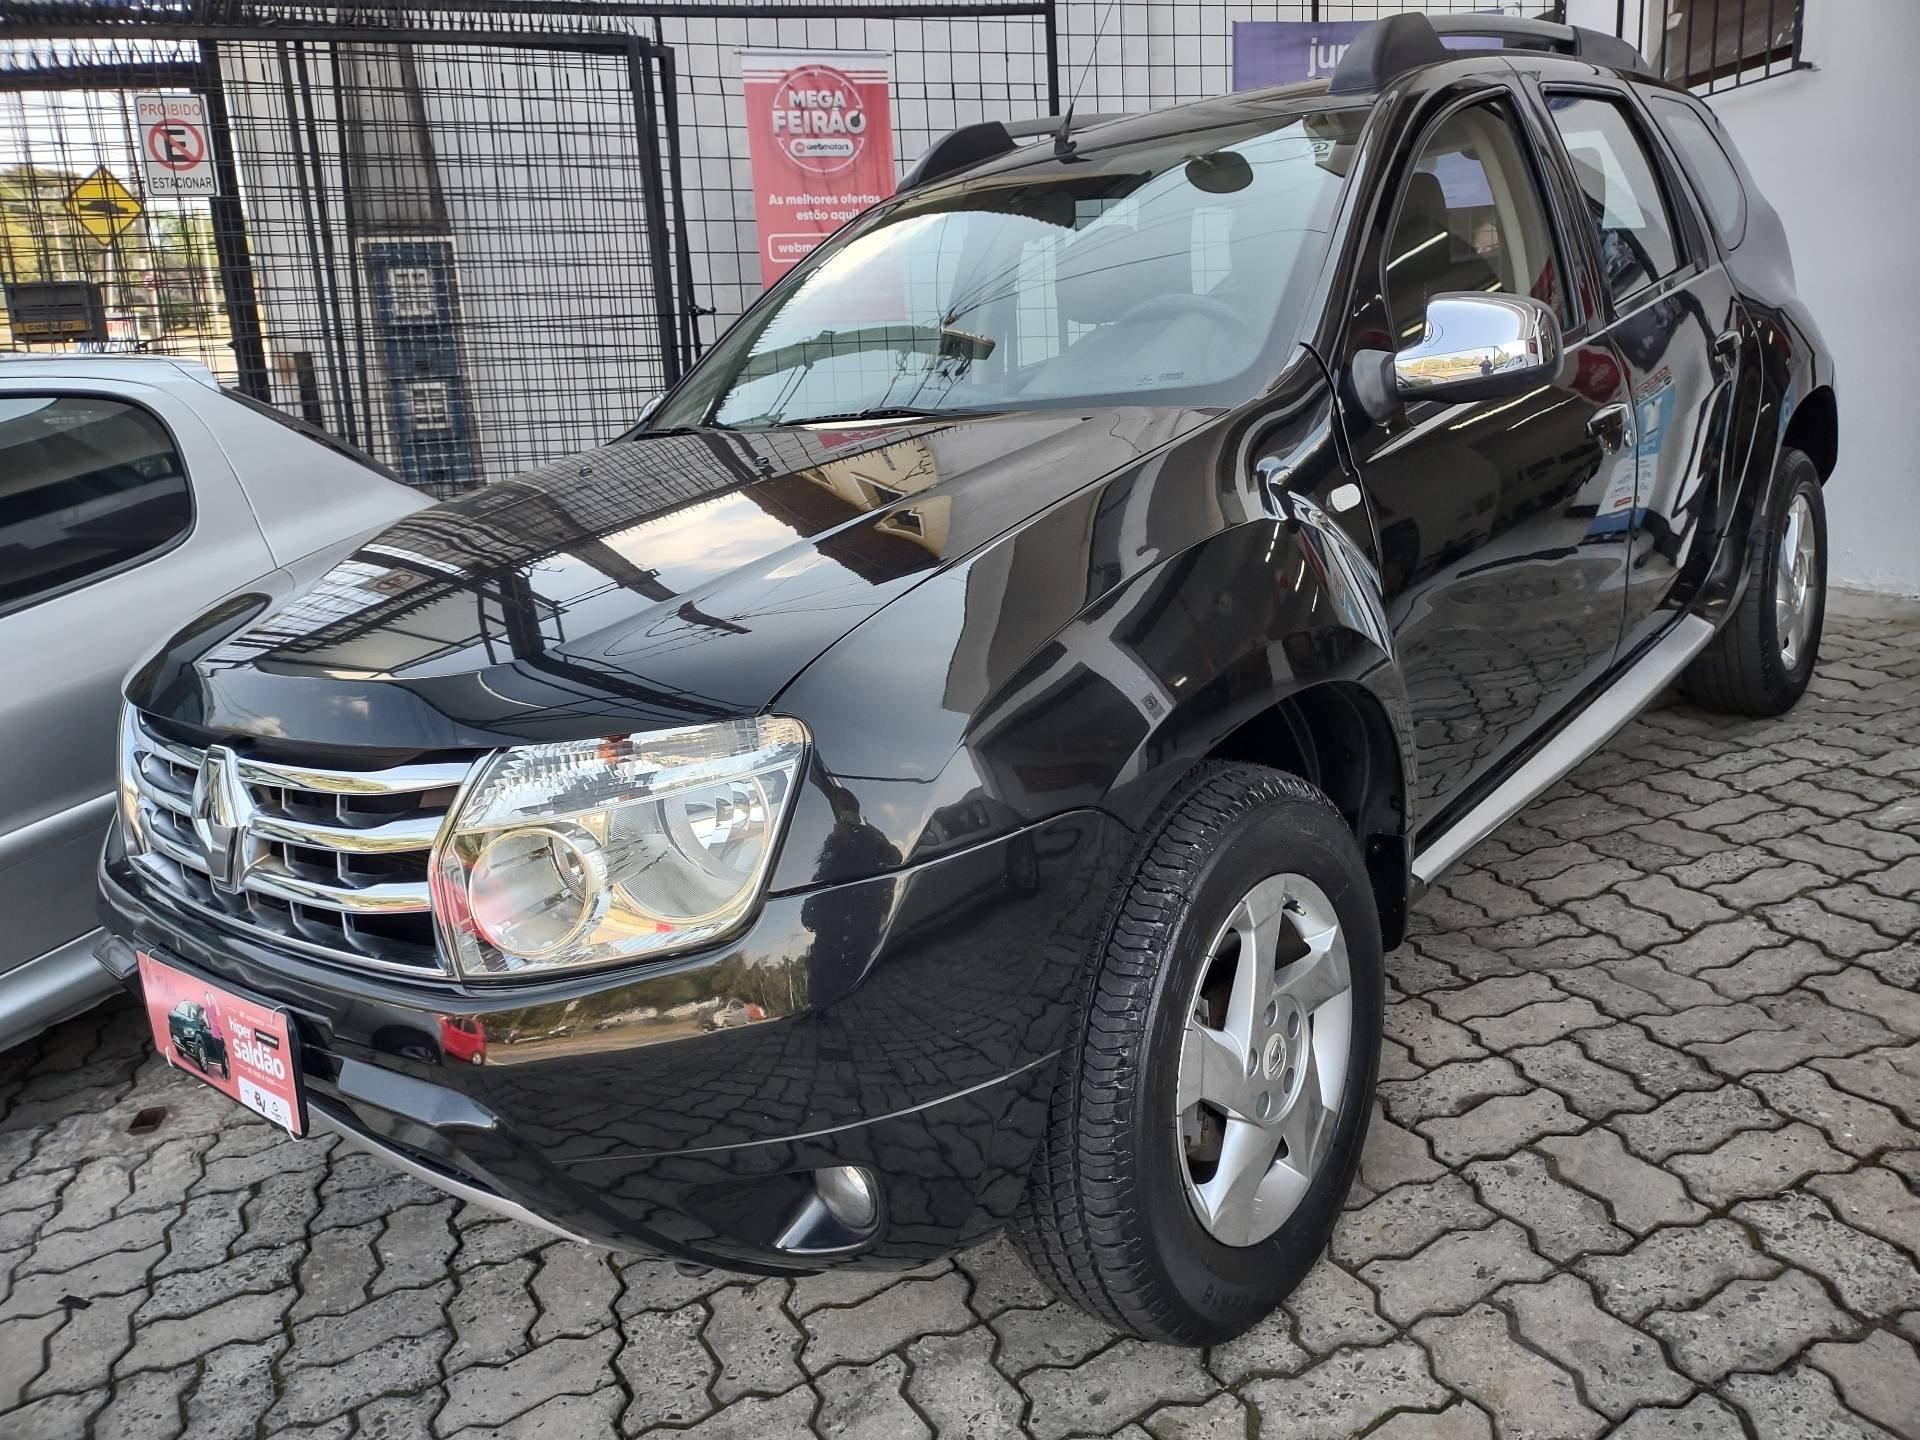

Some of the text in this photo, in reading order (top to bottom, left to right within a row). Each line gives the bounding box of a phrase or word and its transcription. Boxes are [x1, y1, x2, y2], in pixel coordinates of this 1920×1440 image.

[788, 90, 846, 108] MEGA
[140, 103, 201, 116] PROIBIDO
[772, 107, 866, 134] FEIRÃO
[806, 143, 849, 151] webmotors
[152, 176, 213, 189] ESTACIONAR
[769, 193, 881, 205] As melhores ofertas
[796, 209, 828, 221] estão
[228, 1015, 252, 1040] hiper
[233, 1038, 285, 1080] saldão
